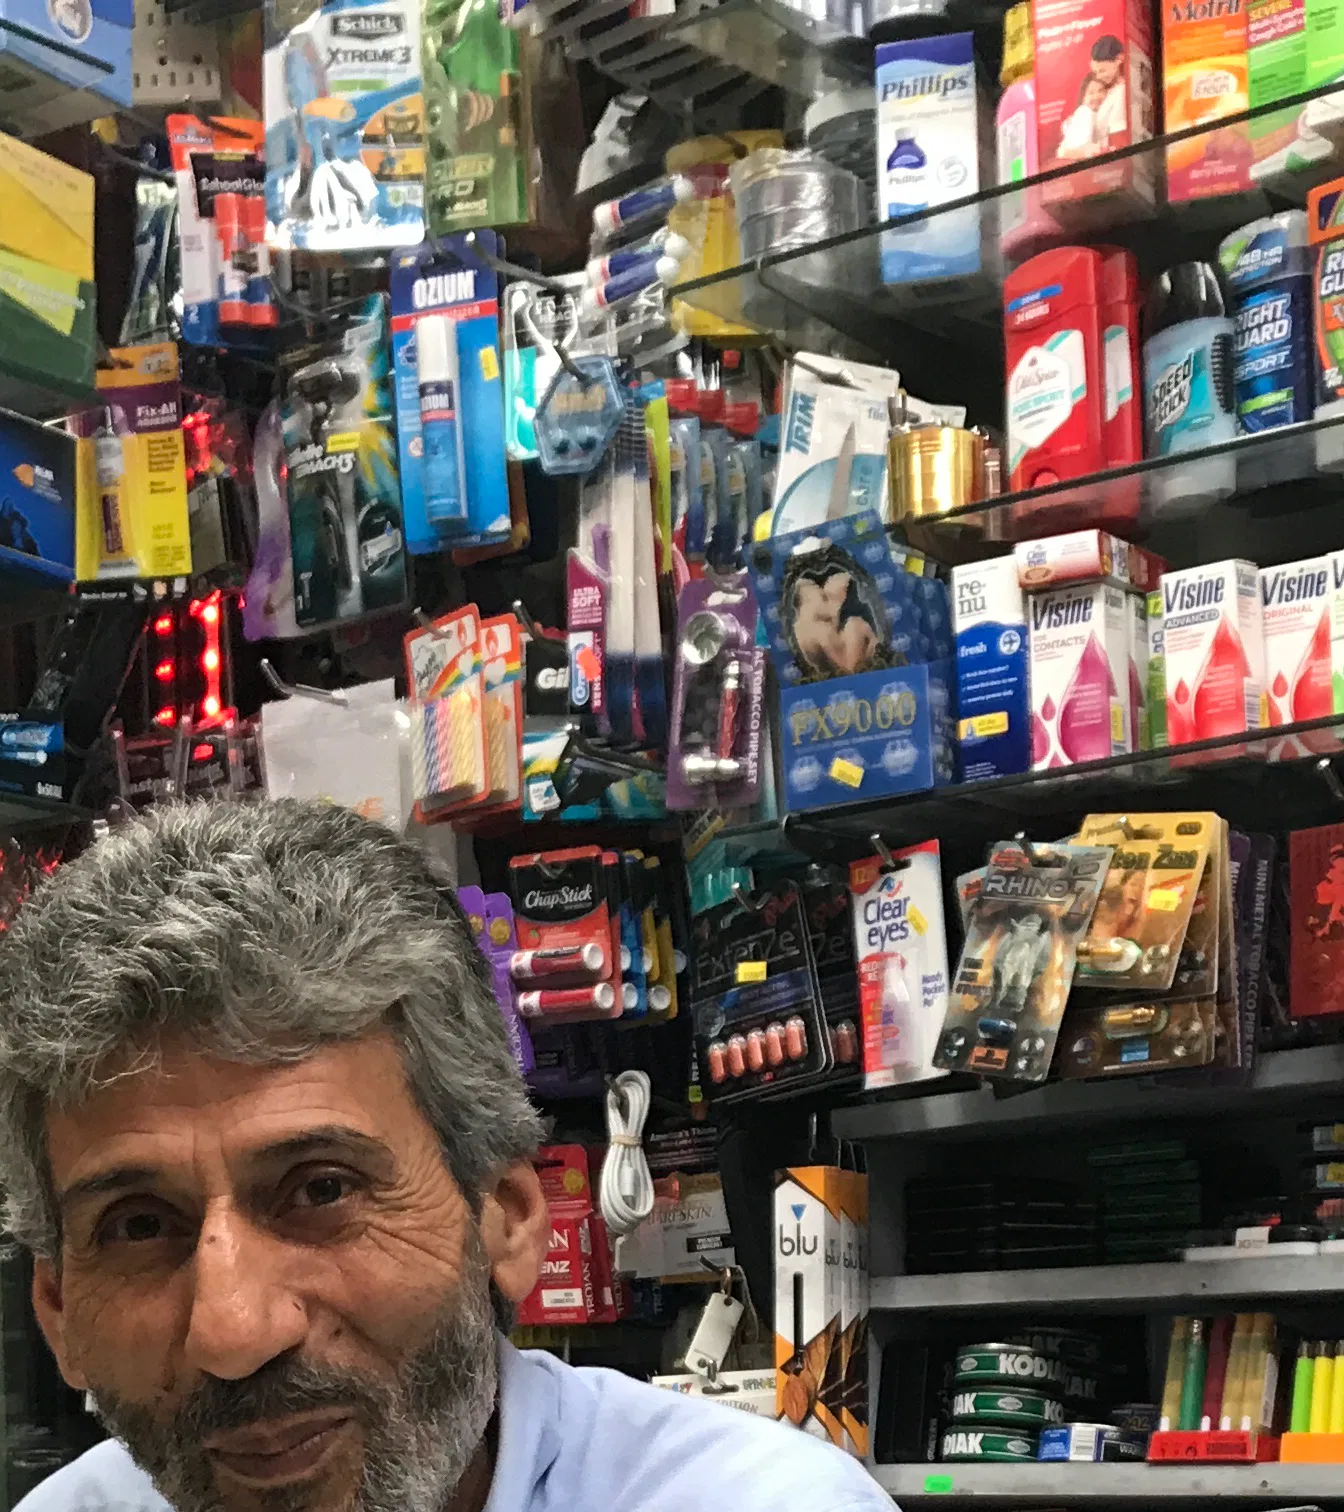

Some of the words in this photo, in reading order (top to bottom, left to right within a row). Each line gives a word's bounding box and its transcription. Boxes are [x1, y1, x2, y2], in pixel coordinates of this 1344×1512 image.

[336, 16, 399, 34] Schick
[413, 271, 475, 308] OZIUM
[1163, 575, 1225, 613] Visine
[1262, 568, 1327, 606] Visine
[1032, 595, 1094, 631] Visine
[1164, 610, 1220, 629] ADVANCED
[1263, 603, 1313, 621] ORIGINAL
[1034, 635, 1087, 654] CONTACTS
[791, 691, 917, 746] FX9000
[525, 884, 593, 910] ChapStick
[863, 895, 911, 925] Clear
[867, 920, 909, 951] eyes
[778, 1228, 818, 1258] blu
